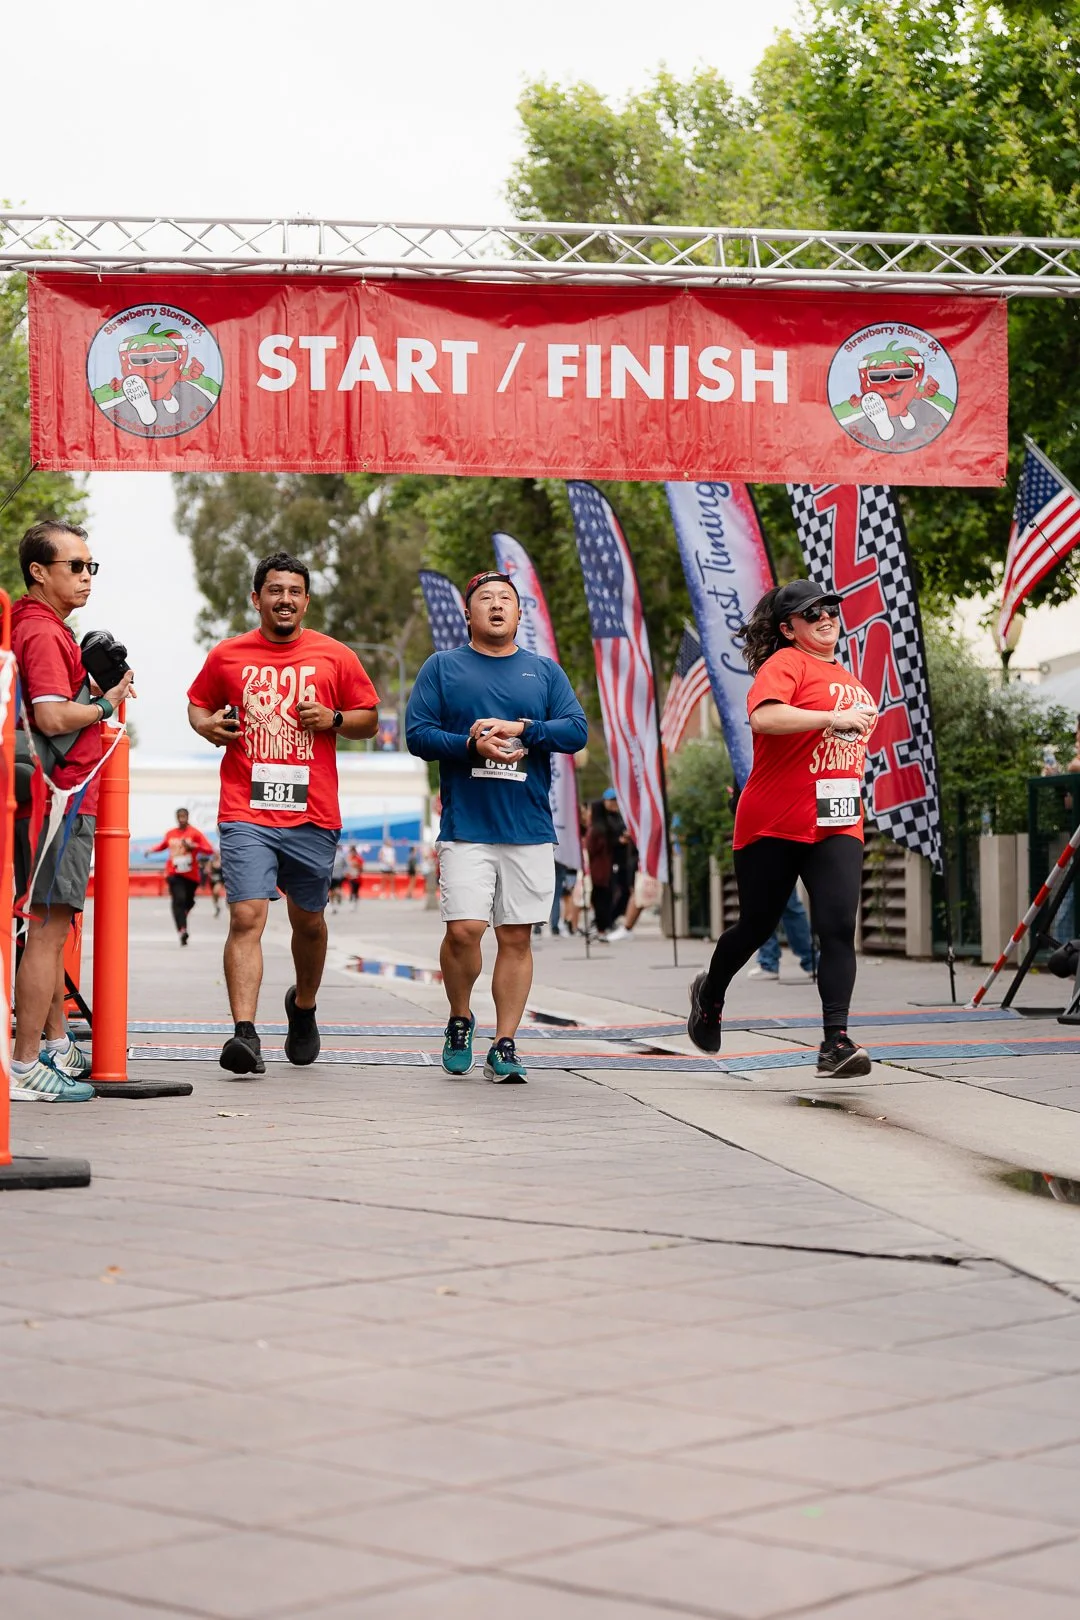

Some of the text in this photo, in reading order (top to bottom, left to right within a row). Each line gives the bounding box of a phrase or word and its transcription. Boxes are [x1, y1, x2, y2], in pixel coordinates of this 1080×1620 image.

[103, 306, 207, 337] Strawberry Stomp 5K
[844, 325, 942, 355] Strawberry Stomp 5K
[126, 378, 137, 387] 5K
[257, 334, 788, 404] START / FINISH
[128, 390, 149, 402] Walk
[864, 395, 875, 403] 5K
[866, 406, 886, 418] Walk
[695, 481, 735, 585] Timing
[810, 484, 928, 816] NISH
[242, 666, 316, 727] 2025
[245, 722, 315, 760] STOMP 5K
[263, 783, 295, 802] 581
[829, 798, 856, 817] 580
